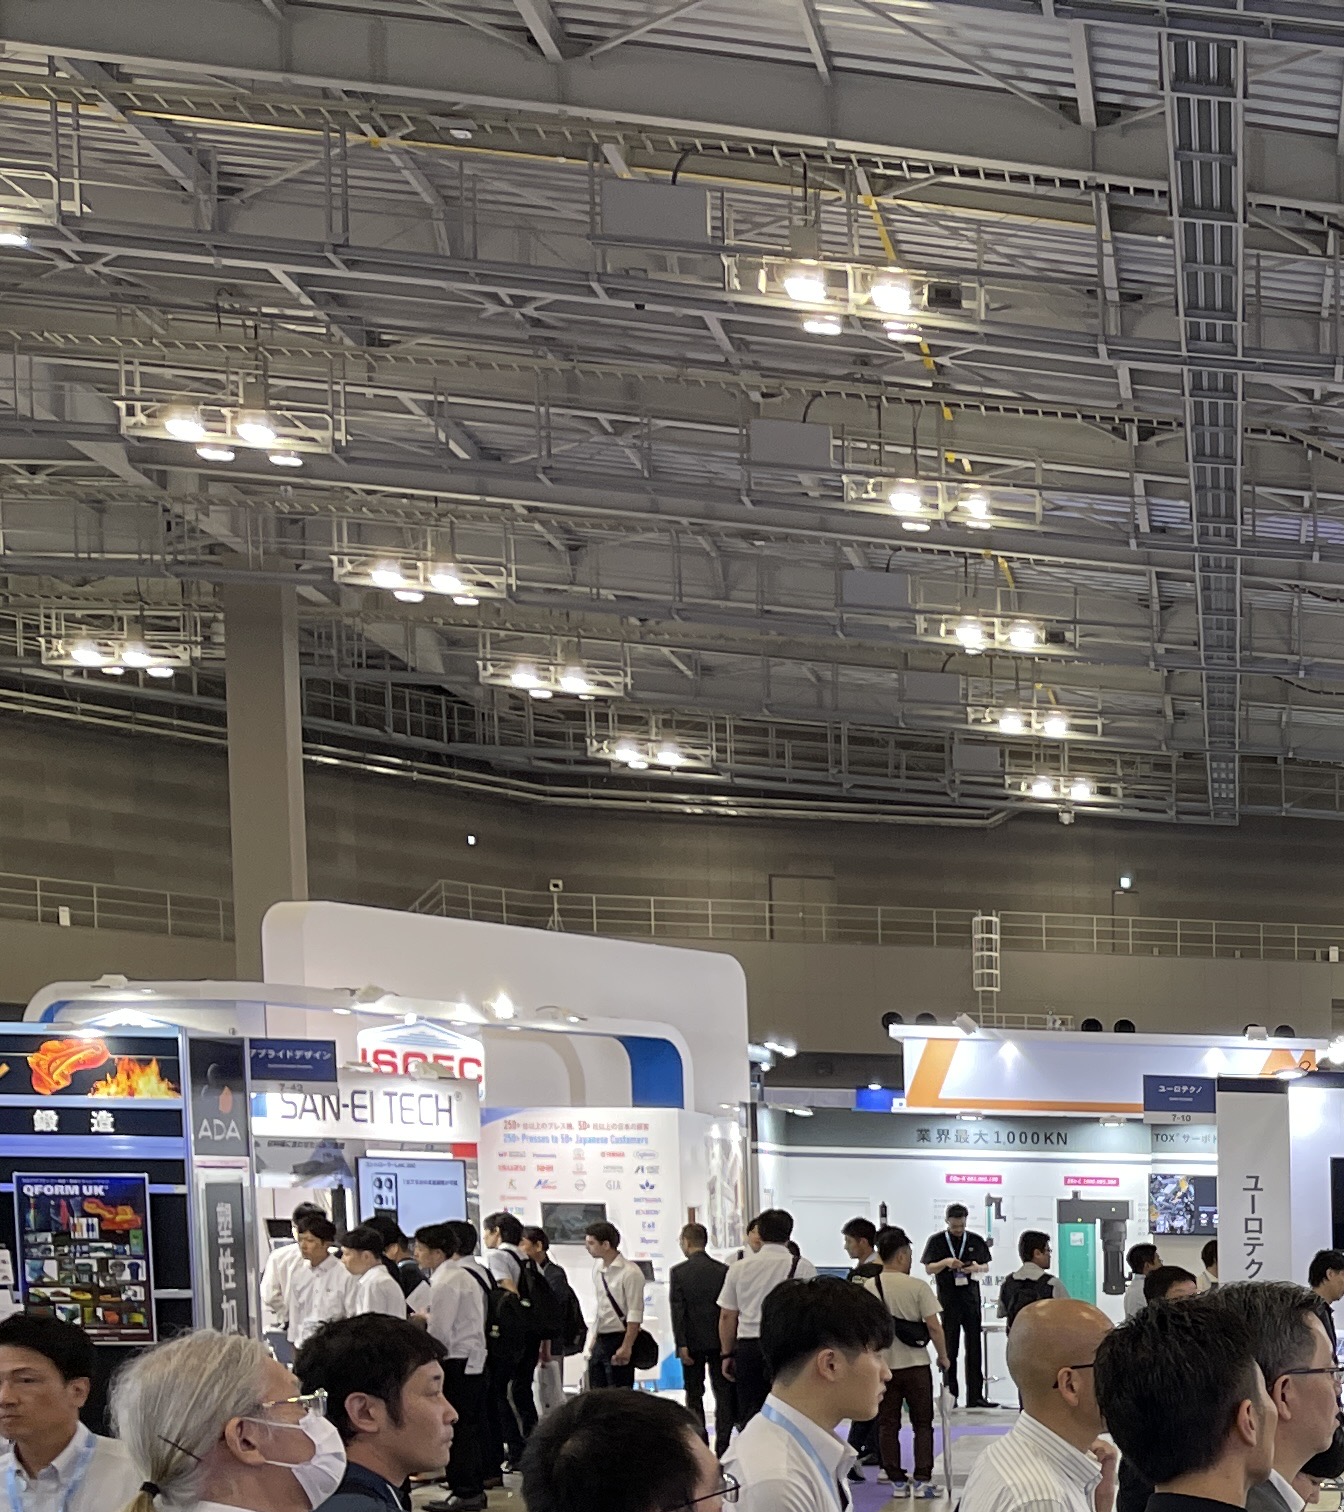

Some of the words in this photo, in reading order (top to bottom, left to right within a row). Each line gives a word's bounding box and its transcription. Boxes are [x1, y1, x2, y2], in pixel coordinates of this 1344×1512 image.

[250, 1049, 331, 1060] アプライドデザイン
[1158, 1085, 1202, 1094] ユーロテクノ
[1172, 1114, 1191, 1122] 7-10
[199, 1119, 241, 1141] ADA
[23, 1184, 79, 1196] QFORM
